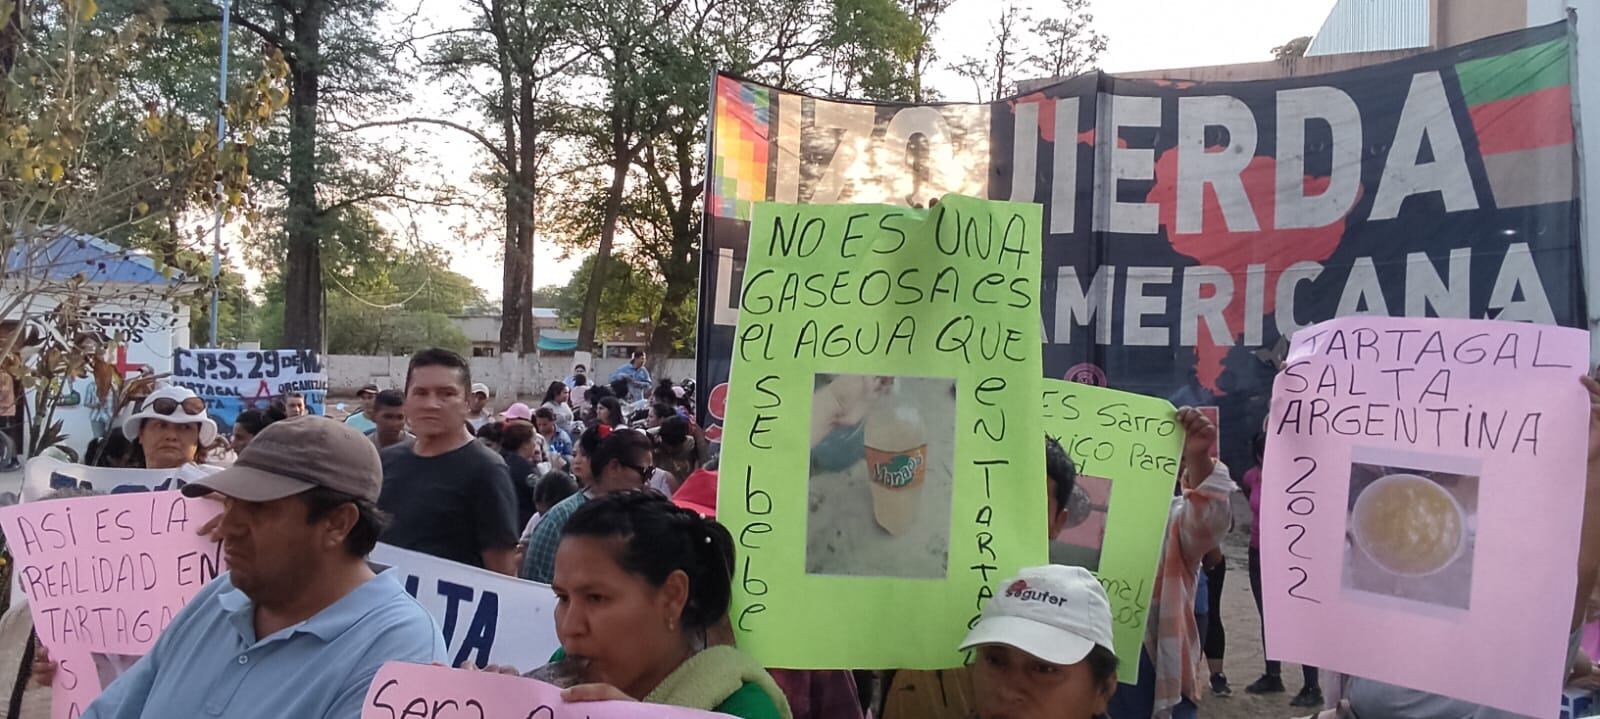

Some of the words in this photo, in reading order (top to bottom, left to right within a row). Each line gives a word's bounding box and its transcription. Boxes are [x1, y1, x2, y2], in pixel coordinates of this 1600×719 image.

[768, 212, 826, 257] NO
[842, 213, 906, 257] ES
[935, 207, 1030, 270] UNA
[741, 266, 960, 315] GASEOSA
[794, 316, 917, 359] AGUA
[935, 315, 1027, 363] QUE
[1301, 327, 1573, 369] TARTAGAL
[173, 350, 243, 380] C.P.S.
[246, 350, 281, 379] 29
[296, 349, 326, 374] M
[1284, 360, 1451, 403] SALTA
[748, 375, 782, 450] SE
[1096, 403, 1176, 437] Sarro
[96, 508, 135, 544] ES
[150, 497, 189, 536] LA
[1283, 456, 1321, 604] 2022
[177, 538, 224, 587] EN
[41, 597, 186, 648] TARTAGA
